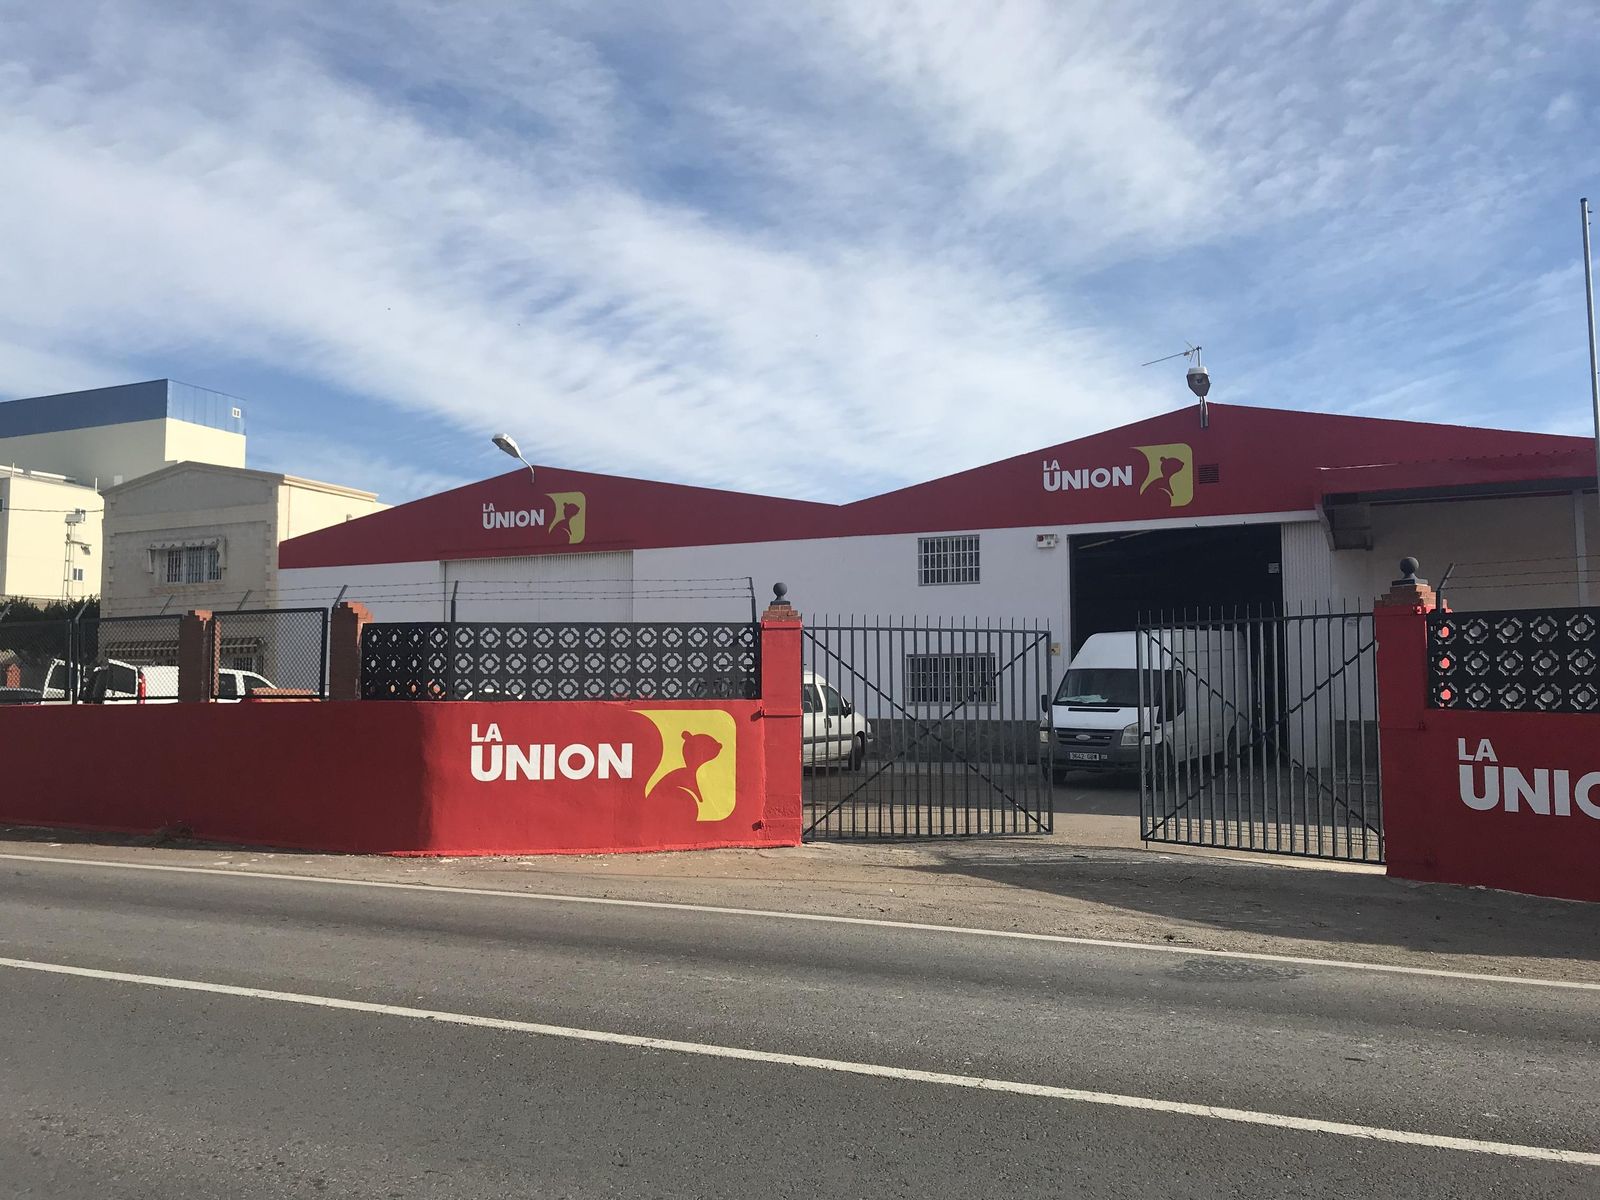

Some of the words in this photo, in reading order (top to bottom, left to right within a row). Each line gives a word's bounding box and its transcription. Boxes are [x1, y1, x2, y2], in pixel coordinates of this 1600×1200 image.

[1044, 460, 1061, 471] LA
[1043, 466, 1133, 492] UNION
[482, 502, 495, 512] LA
[482, 509, 545, 530] UNION
[471, 723, 503, 743] LA
[1458, 737, 1499, 762] LA
[470, 743, 633, 782] UNION
